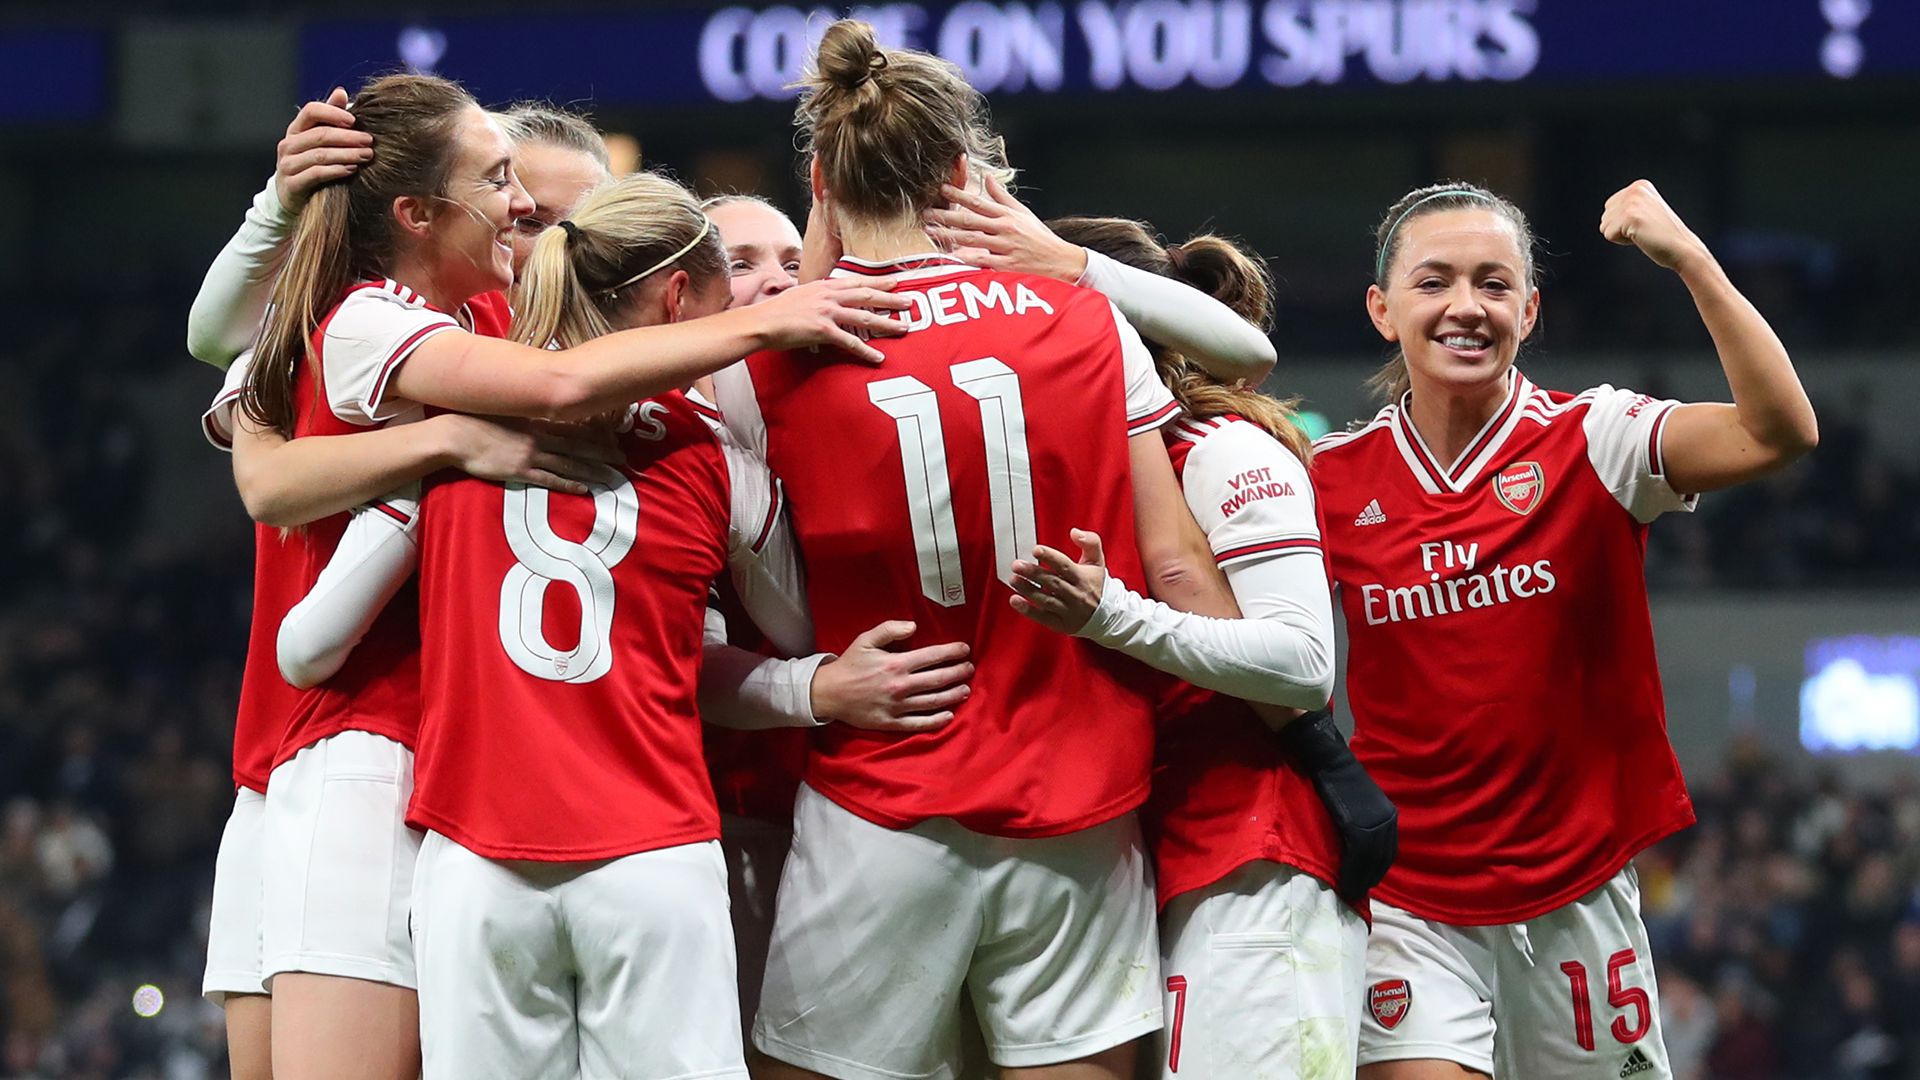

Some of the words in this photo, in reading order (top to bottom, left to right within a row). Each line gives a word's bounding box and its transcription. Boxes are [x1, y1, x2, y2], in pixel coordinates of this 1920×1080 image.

[937, 0, 1064, 93] ON
[1074, 0, 1249, 89] YOU
[1260, 0, 1540, 86] SPURS
[866, 356, 1039, 607] 11
[1227, 467, 1272, 490] VISIT
[1501, 469, 1535, 484] Arsenal
[1221, 482, 1296, 518] RWANDA
[1354, 513, 1387, 527] adidas
[1420, 540, 1478, 571] Fly
[498, 464, 639, 684] 8
[1361, 559, 1556, 626] Emirates
[1373, 986, 1405, 998] Arsenal
[1560, 947, 1651, 1051] 15
[1619, 1060, 1654, 1078] adidas
